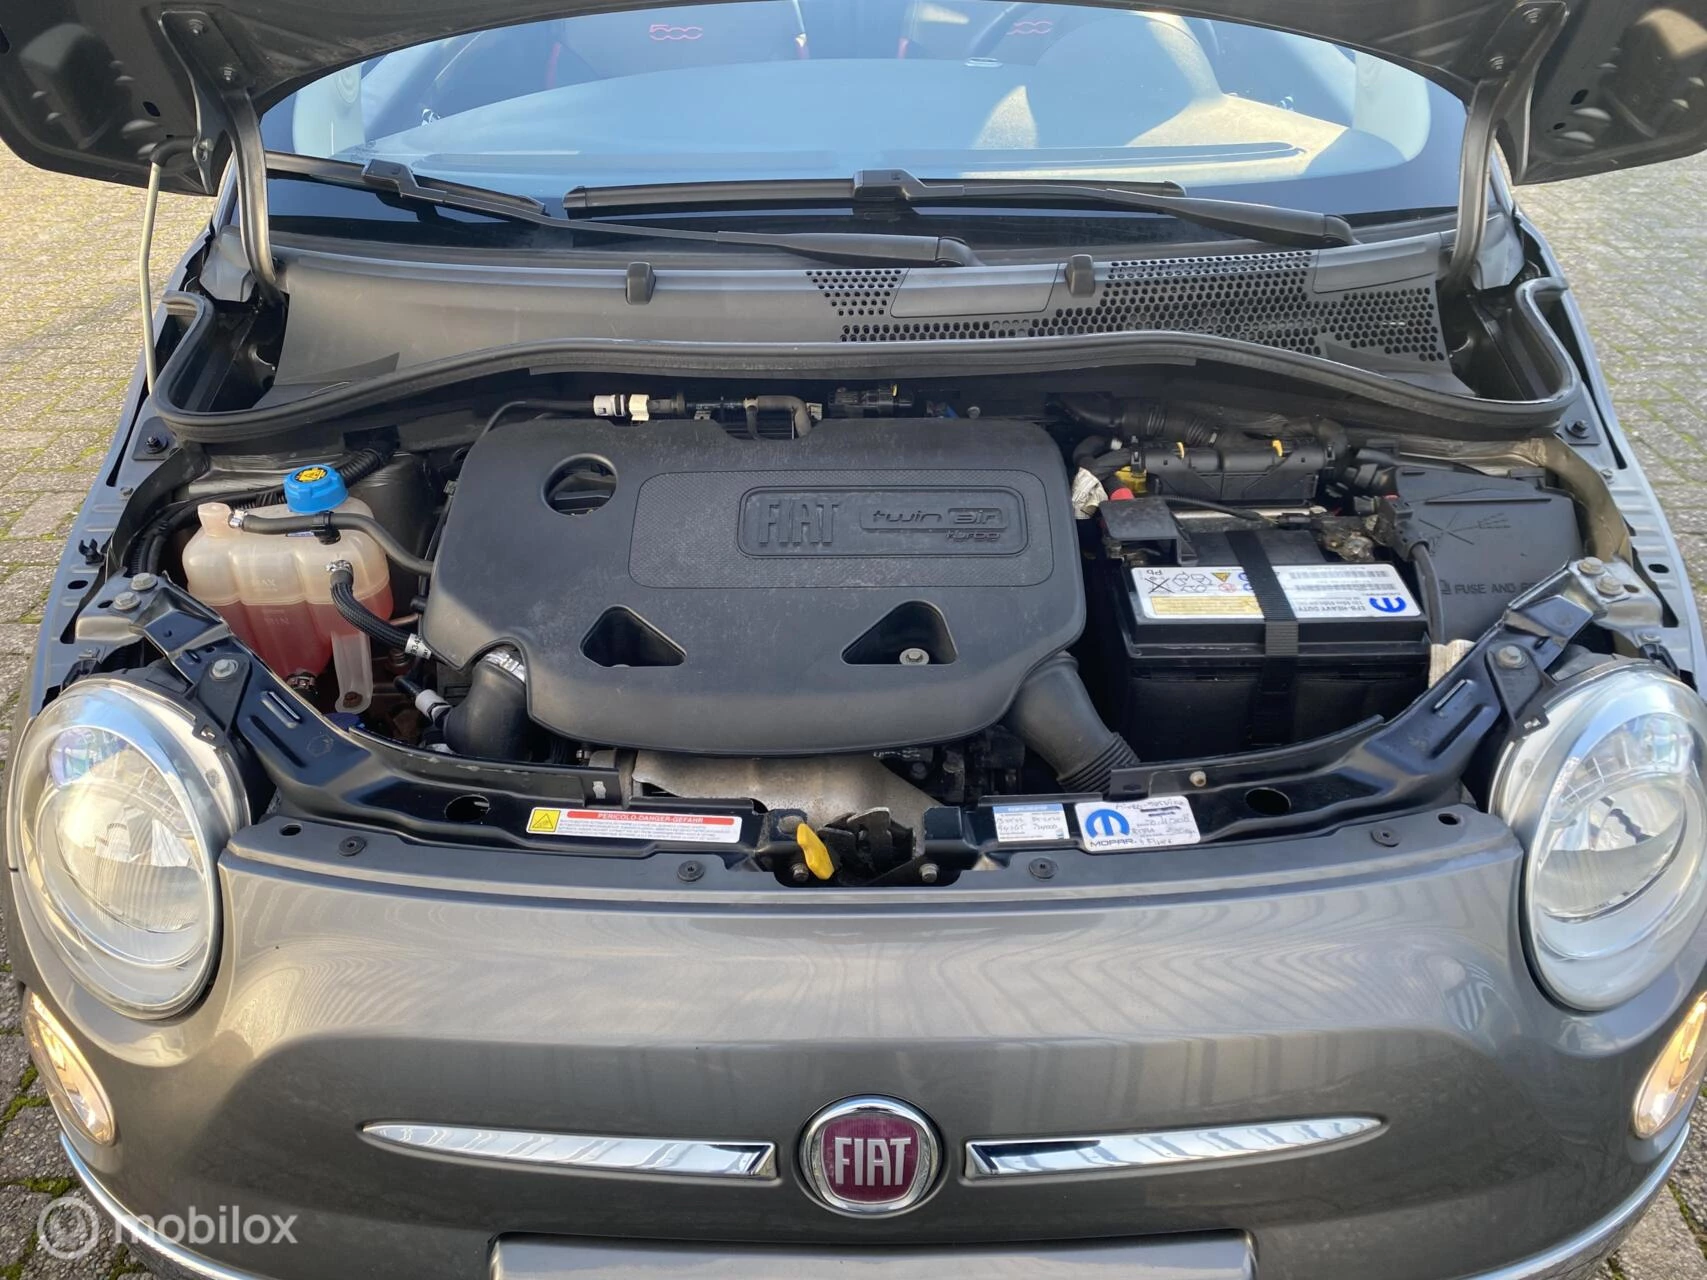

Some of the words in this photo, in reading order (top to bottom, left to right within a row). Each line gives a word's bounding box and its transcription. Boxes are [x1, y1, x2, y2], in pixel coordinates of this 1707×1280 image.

[649, 24, 703, 41] 500
[758, 502, 842, 547] FIAT
[872, 509, 943, 523] twin
[952, 509, 1000, 525] air
[1454, 583, 1487, 594] FUSE
[1490, 582, 1516, 593] AND
[597, 812, 704, 824] PERICOLO-DANGER-GEFAHR
[834, 1136, 911, 1186] FIAT
